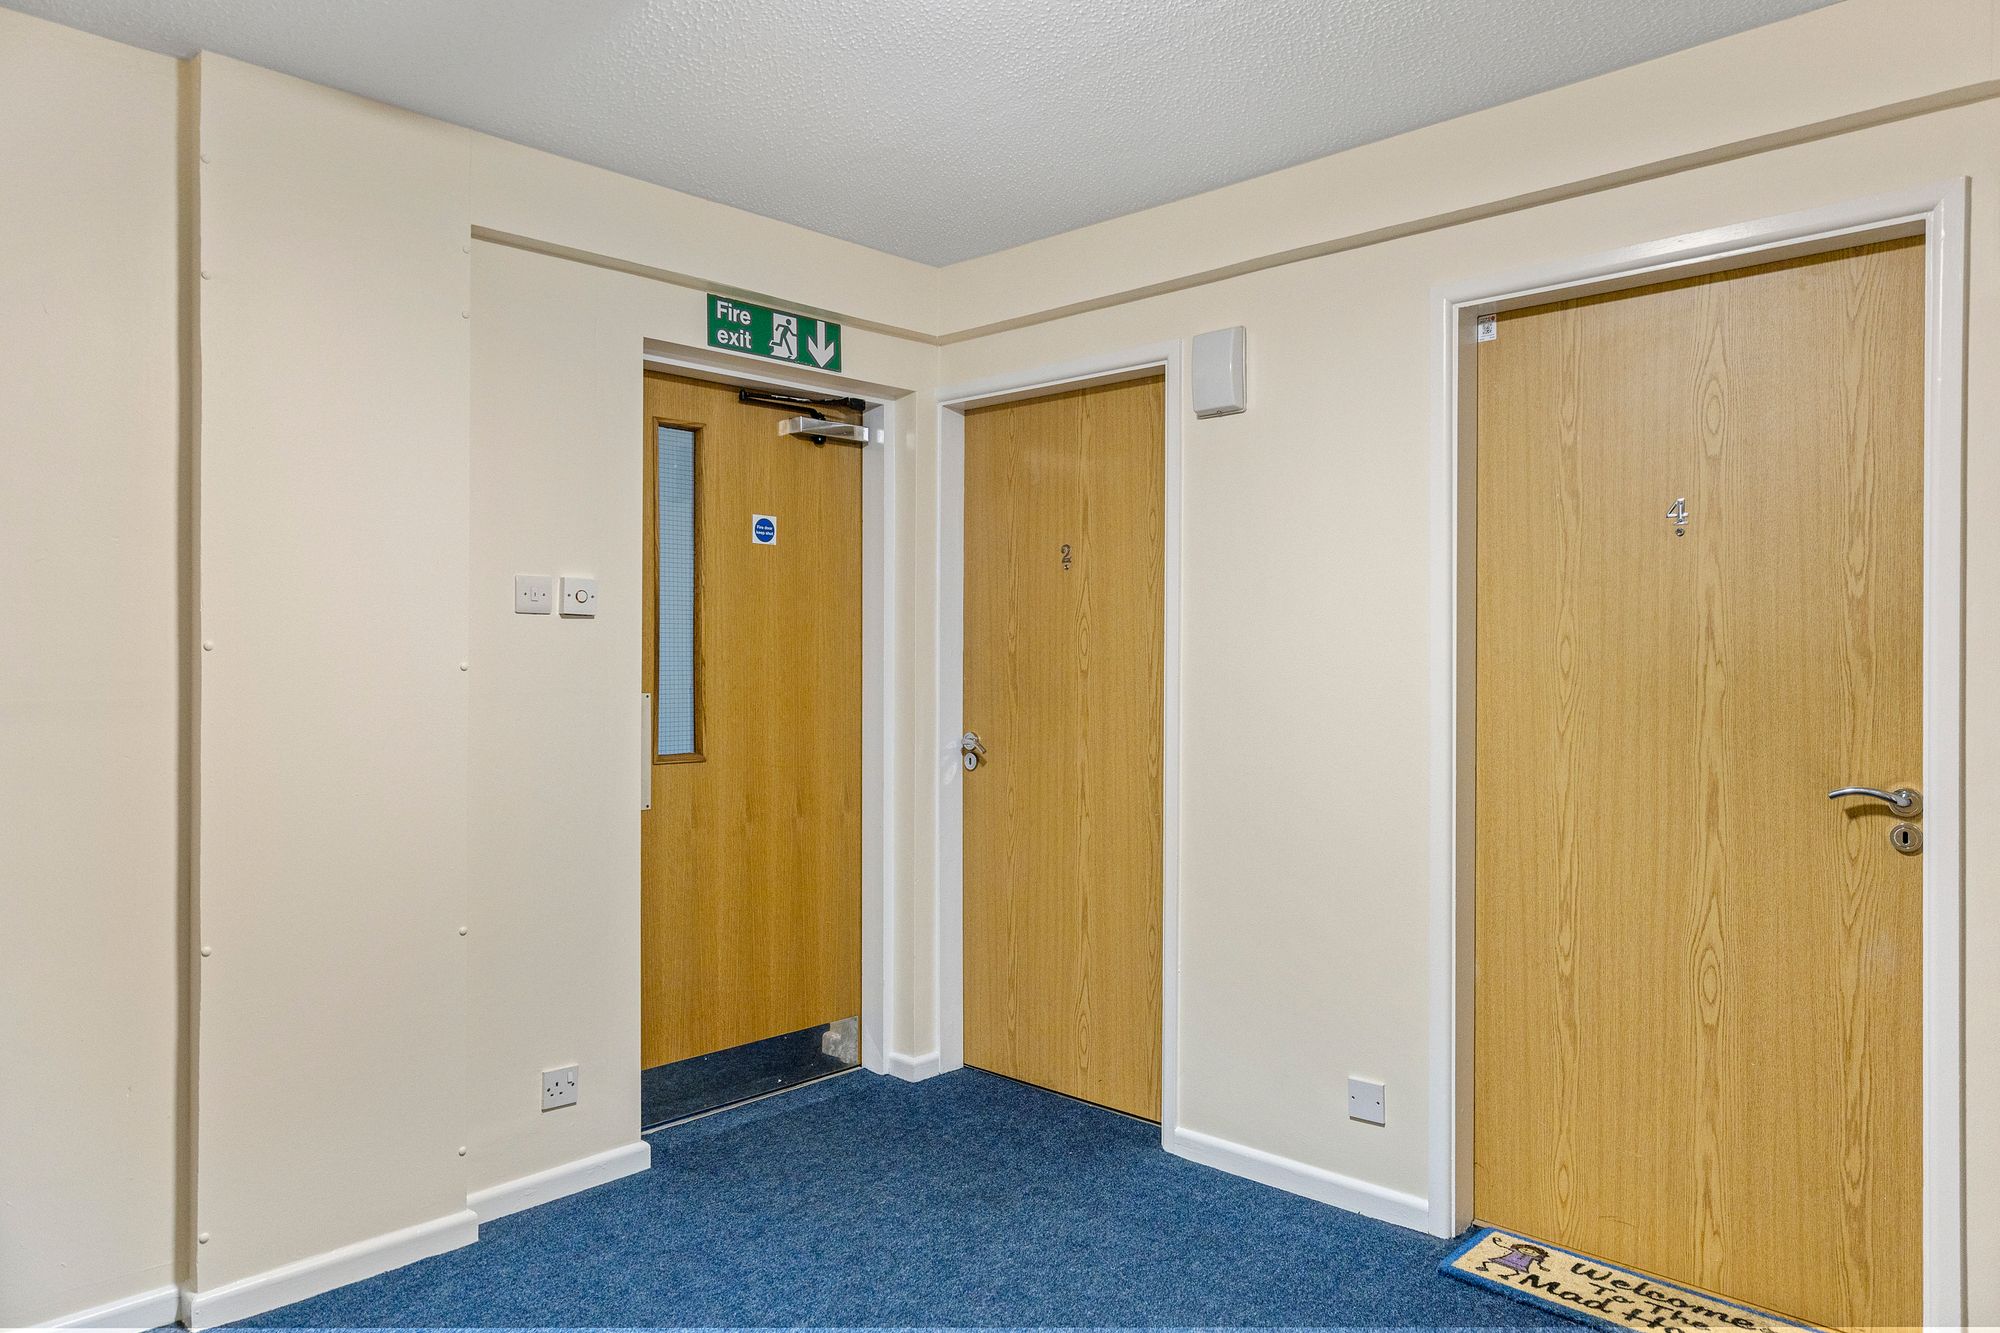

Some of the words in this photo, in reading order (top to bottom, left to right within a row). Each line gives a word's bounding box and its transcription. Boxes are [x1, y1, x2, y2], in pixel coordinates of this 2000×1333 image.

[716, 300, 751, 325] Fire
[717, 329, 752, 349] exit
[1666, 497, 1689, 525] 4
[1061, 544, 1072, 563] 2
[1519, 1272, 1613, 1314] Mad
[1571, 1262, 1757, 1331] Welcome
[1589, 1282, 1635, 1304] To
[1643, 1300, 1711, 1331] The
